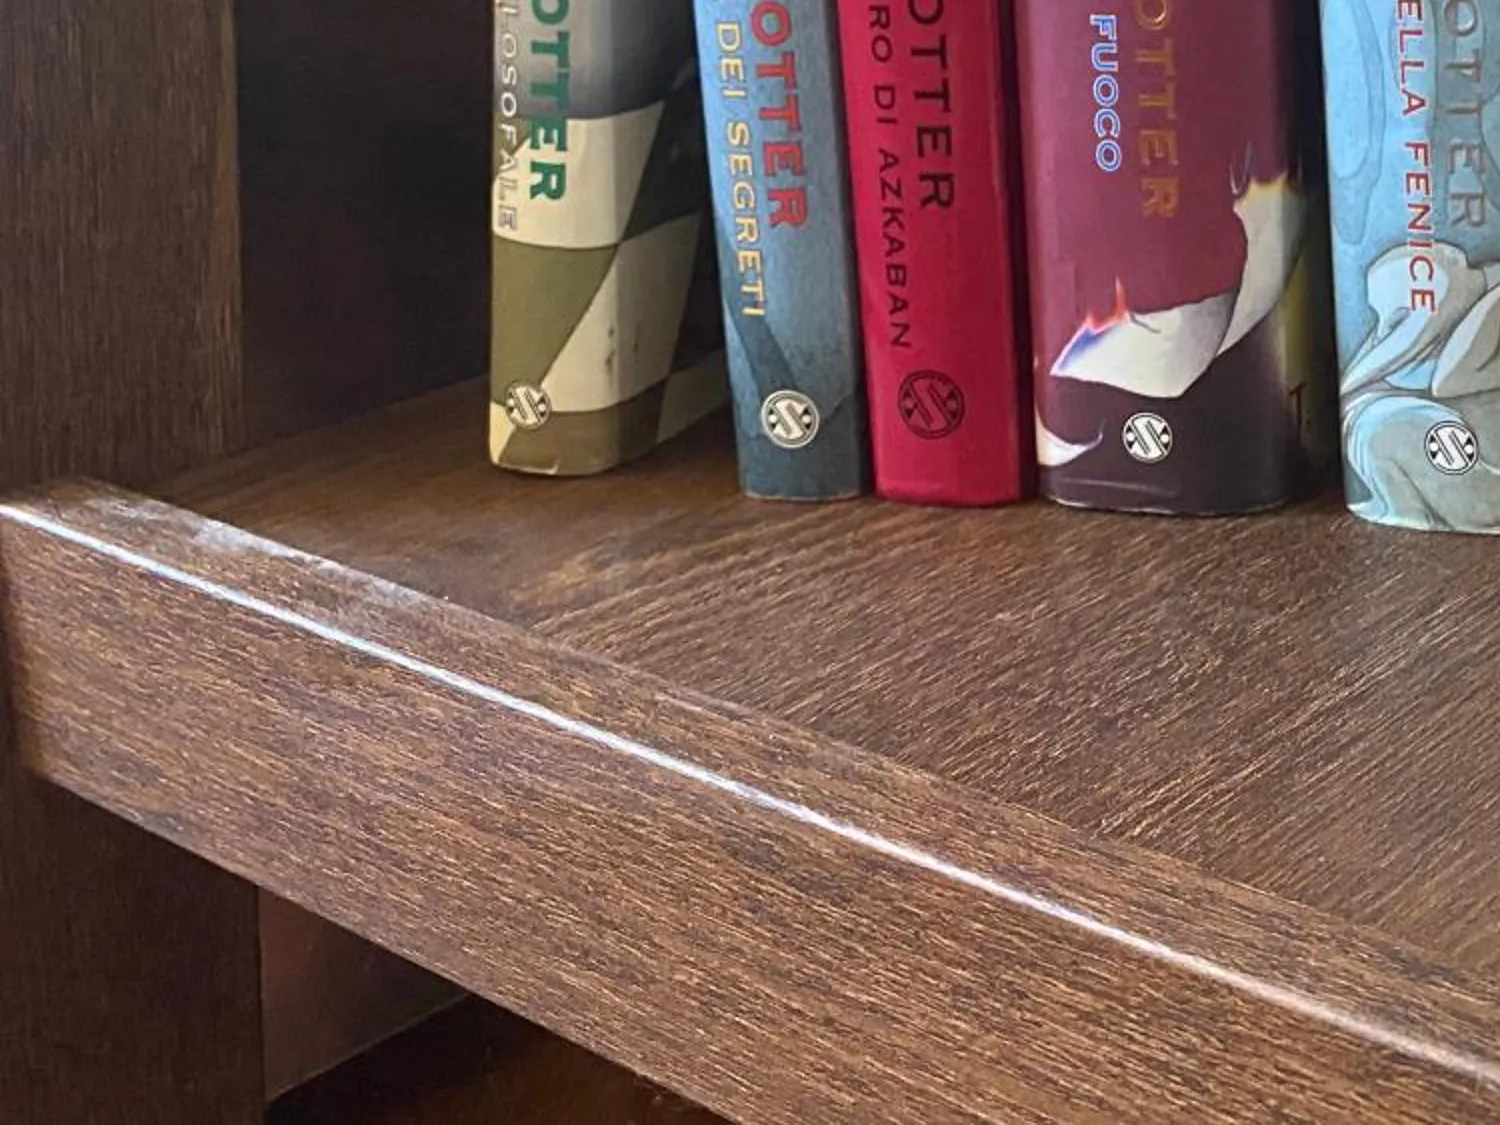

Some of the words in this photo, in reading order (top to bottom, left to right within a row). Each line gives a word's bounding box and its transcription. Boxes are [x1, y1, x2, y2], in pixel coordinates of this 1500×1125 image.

[713, 22, 748, 102] DEI
[870, 82, 899, 125] DI
[1090, 14, 1122, 172] FUOCO
[725, 119, 768, 318] SEGRETI
[876, 147, 914, 350] AZKABAN
[1404, 141, 1437, 315] FENICE
